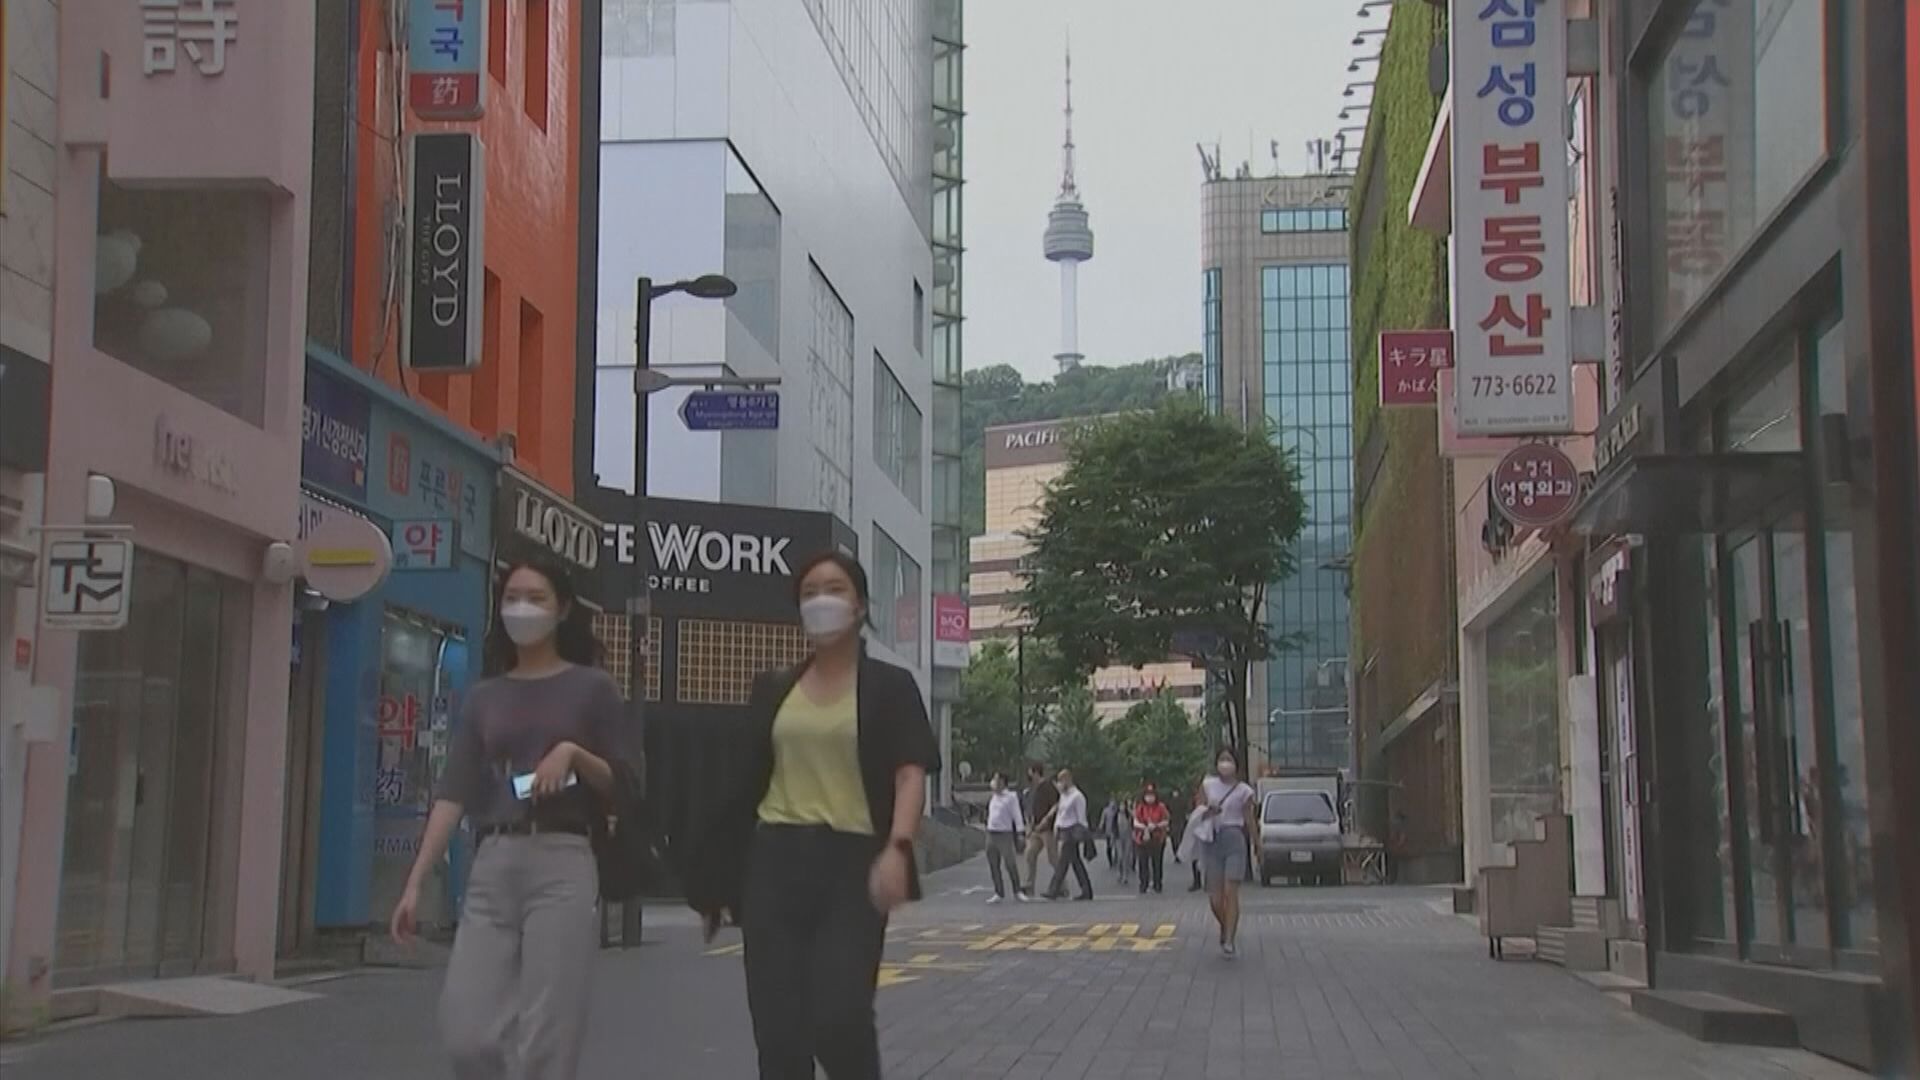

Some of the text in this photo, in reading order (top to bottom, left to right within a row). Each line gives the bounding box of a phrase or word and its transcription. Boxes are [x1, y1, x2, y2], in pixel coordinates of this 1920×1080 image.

[143, 0, 238, 75] 詩
[431, 76, 460, 105] 药
[431, 174, 462, 328] LLOYD
[1389, 346, 1449, 368] キラ星
[1501, 479, 1573, 506] 성형외과
[404, 523, 444, 566] 약
[515, 487, 599, 570] LLOYD
[647, 522, 792, 576] WORK
[378, 693, 421, 749] 약
